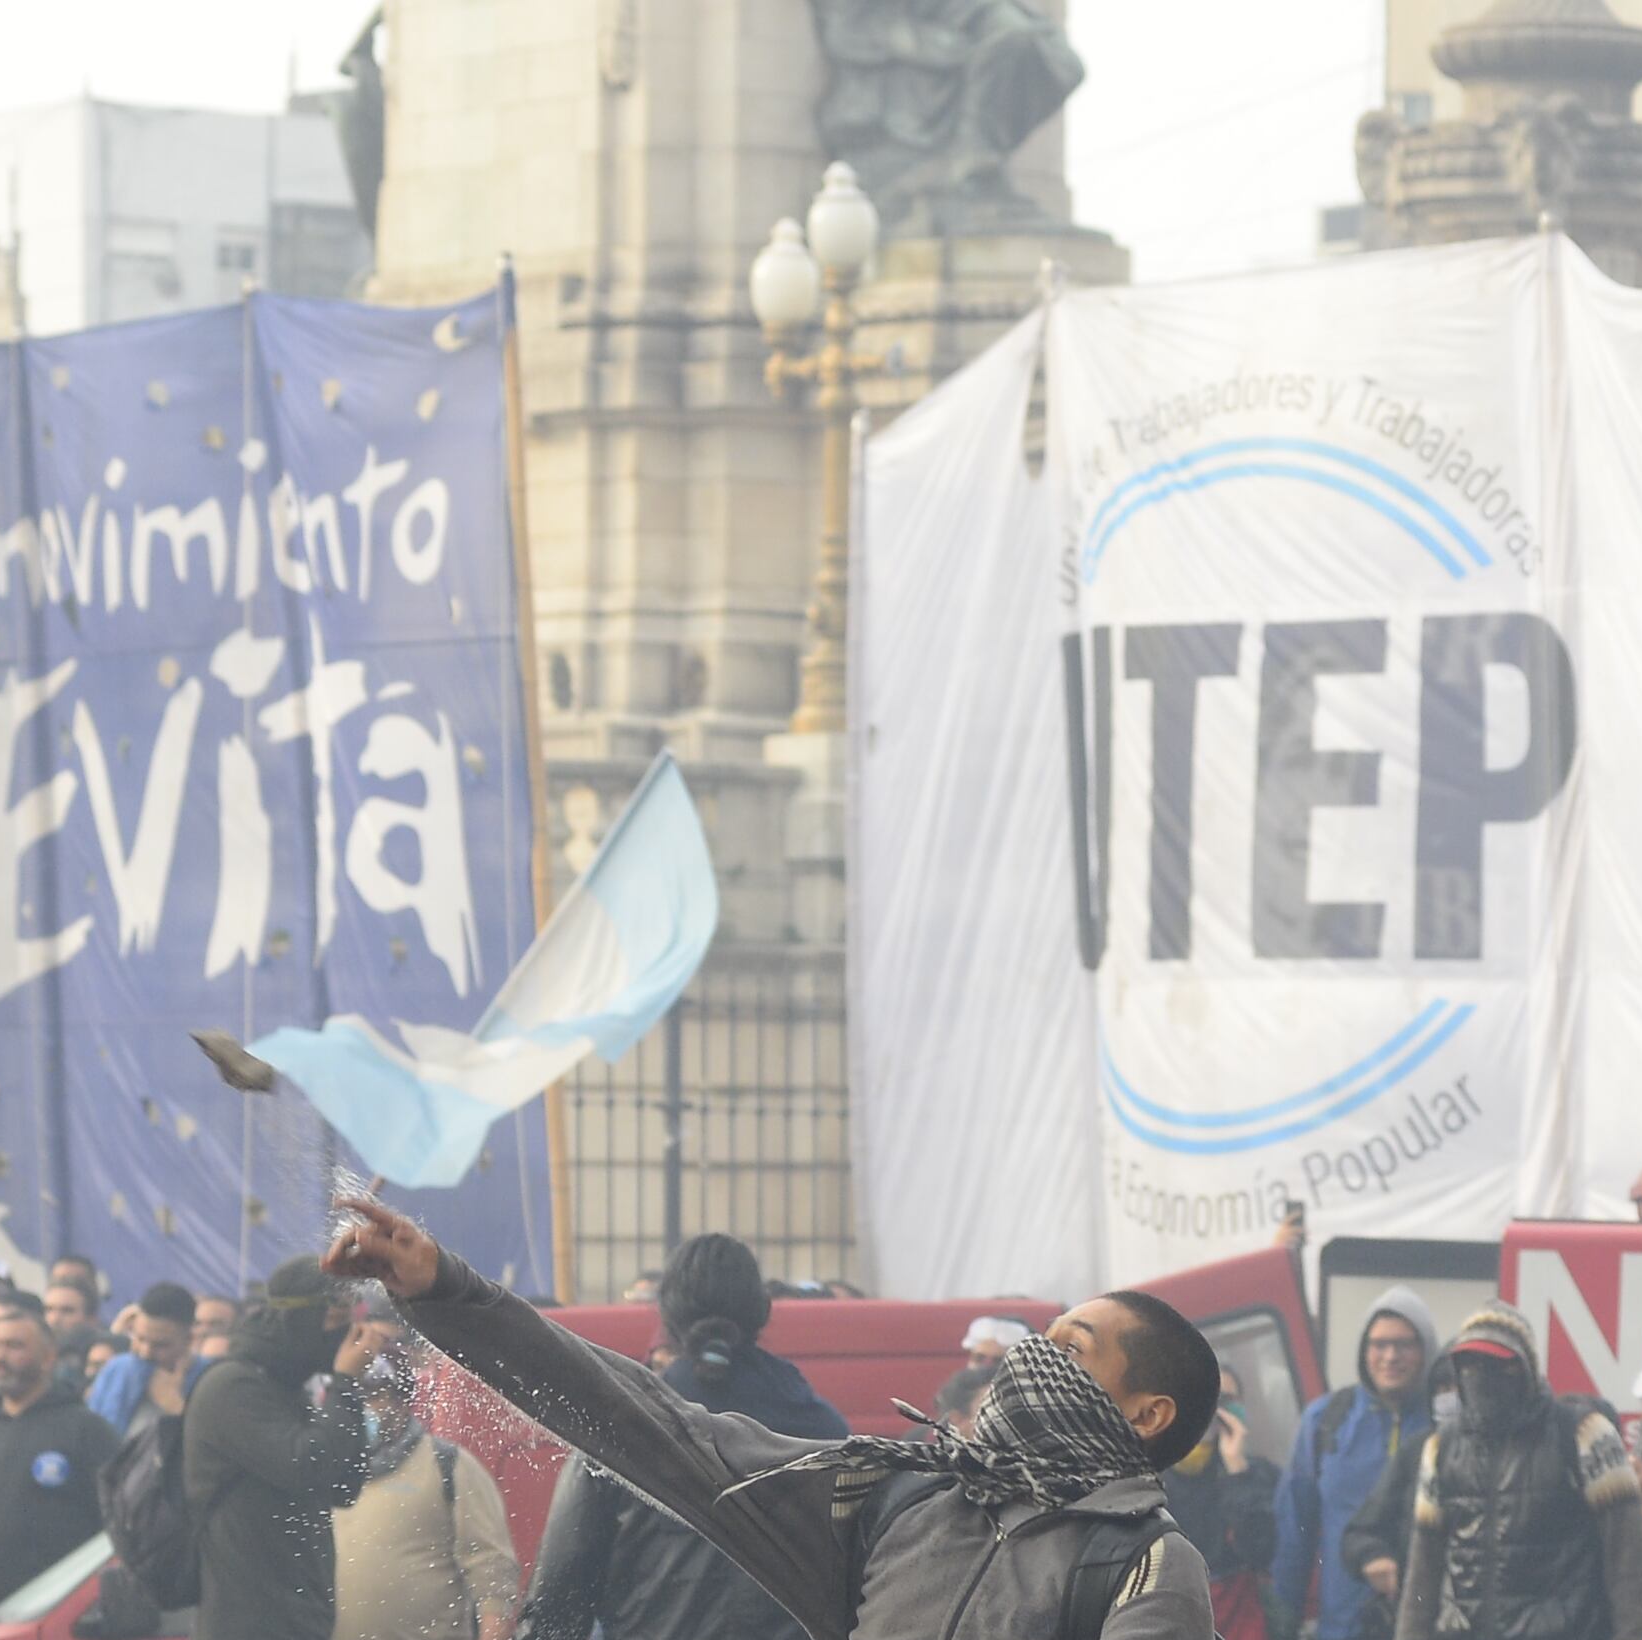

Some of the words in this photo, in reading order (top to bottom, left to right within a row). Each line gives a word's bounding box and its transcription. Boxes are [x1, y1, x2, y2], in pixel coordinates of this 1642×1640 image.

[1354, 375, 1544, 577] Trabajadoras
[1061, 612, 1578, 971] UTEP
[1302, 1072, 1483, 1207] Popular
